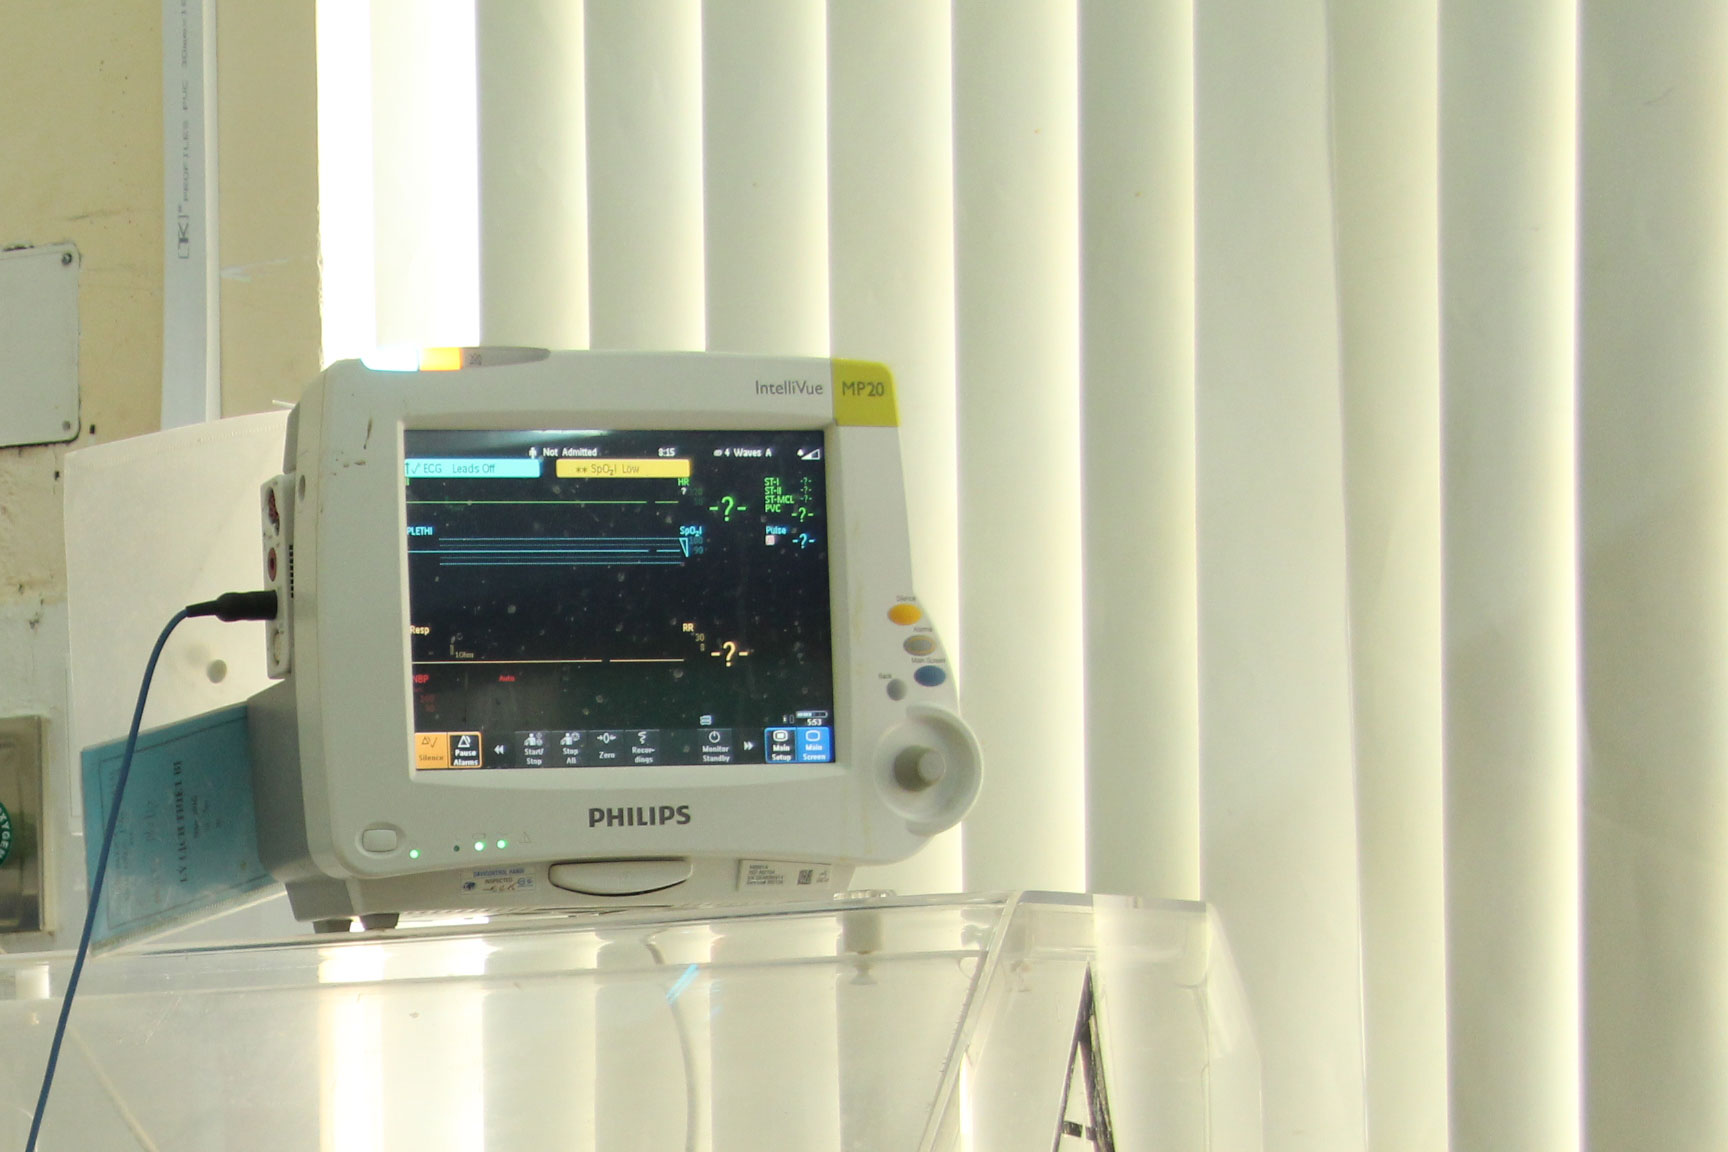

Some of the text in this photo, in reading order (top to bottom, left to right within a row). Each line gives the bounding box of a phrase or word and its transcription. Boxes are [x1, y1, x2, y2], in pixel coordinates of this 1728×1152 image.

[755, 379, 823, 396] IntelliVue
[841, 381, 886, 398] MP20
[543, 447, 598, 457] Not Admitted
[724, 449, 772, 458] 4 Waves A
[423, 463, 496, 474] ECG Leads Off
[621, 463, 640, 474] Low
[677, 478, 690, 486] HR
[764, 504, 781, 513] PVC
[765, 526, 787, 535] Pulse
[410, 625, 430, 636] Resp
[682, 623, 694, 632] RR
[702, 745, 729, 754] Monitor
[772, 744, 790, 752] Main
[805, 743, 823, 751] Main
[419, 754, 444, 762] Silence
[454, 749, 477, 758] Pause
[598, 751, 616, 760] Zero
[772, 753, 791, 762] Setup
[802, 753, 826, 761] Screen
[453, 758, 479, 767] Alarms
[526, 758, 542, 766] Stop
[702, 755, 731, 764] Standby
[588, 804, 692, 828] PHILIPS
